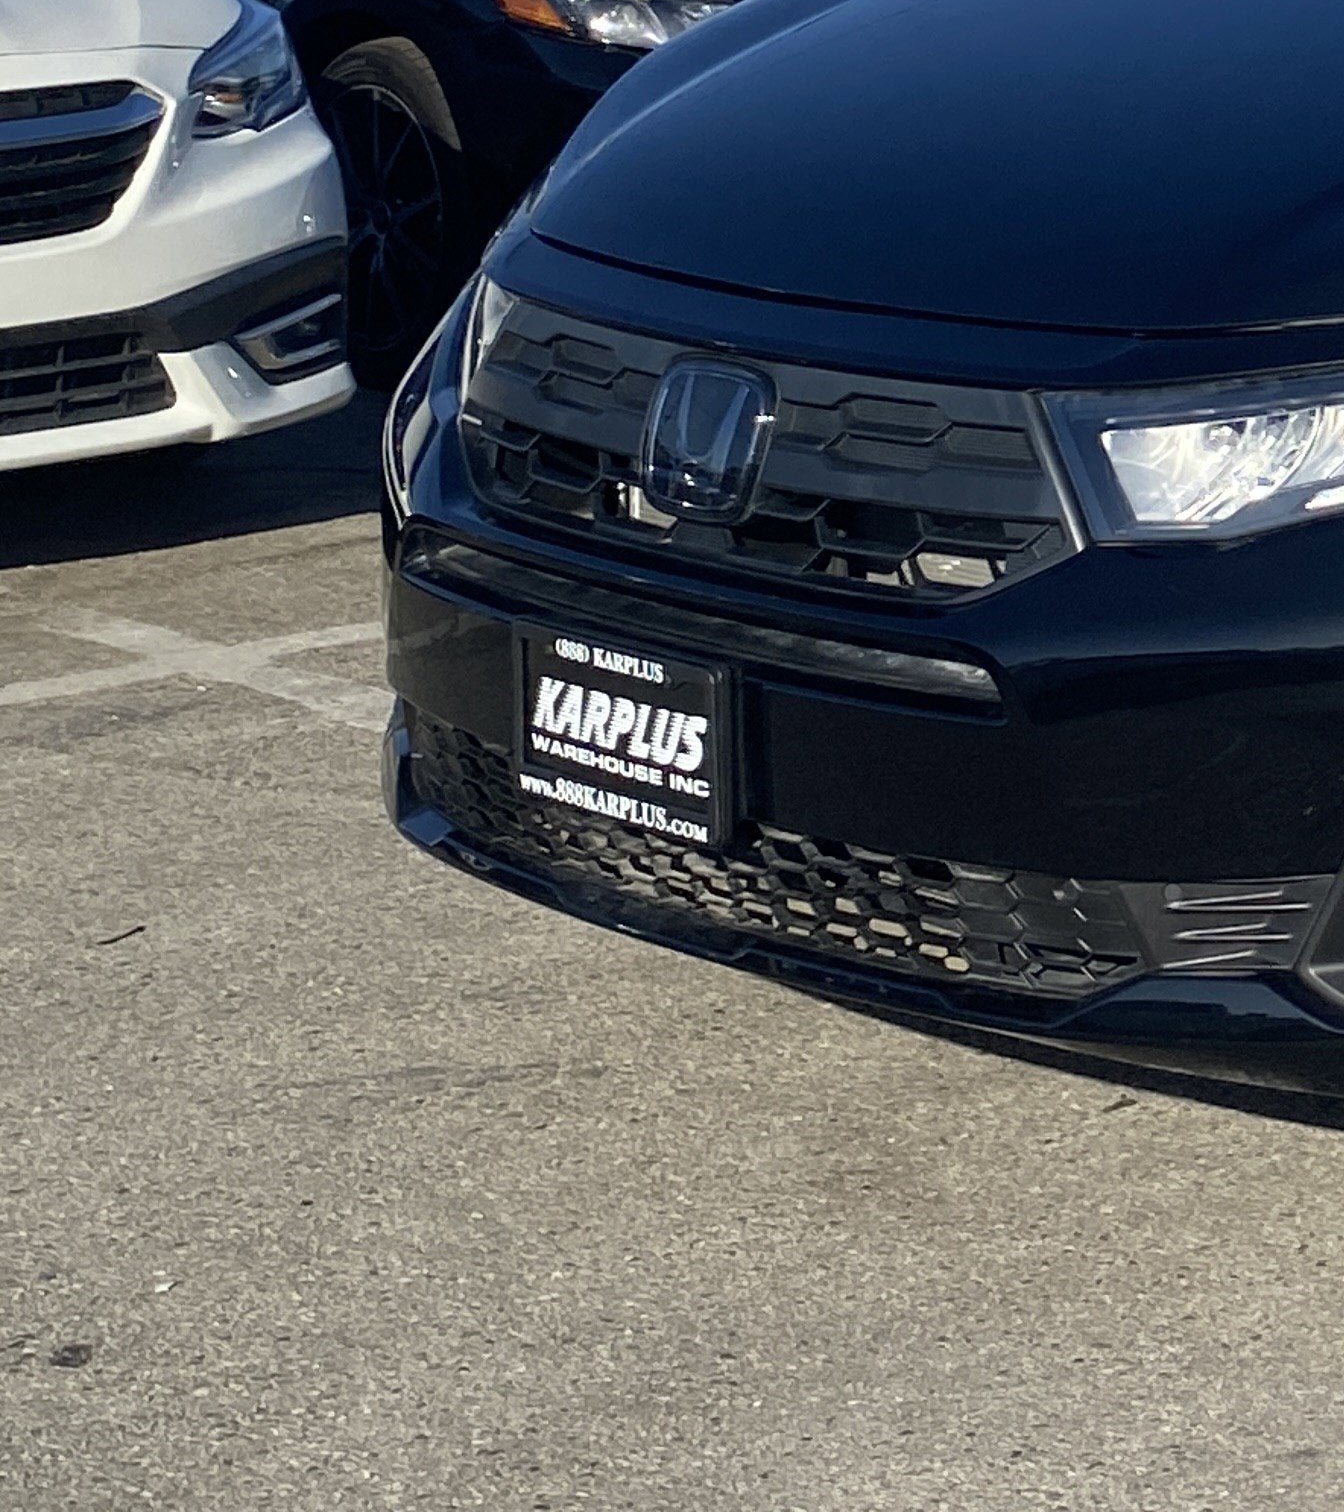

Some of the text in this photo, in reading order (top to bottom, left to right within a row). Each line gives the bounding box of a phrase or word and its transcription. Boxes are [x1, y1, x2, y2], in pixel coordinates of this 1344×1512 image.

[555, 638, 665, 684] (888) KARPLUS
[531, 676, 709, 772] KARPLUS
[530, 732, 711, 798] WAREHOUSE INC
